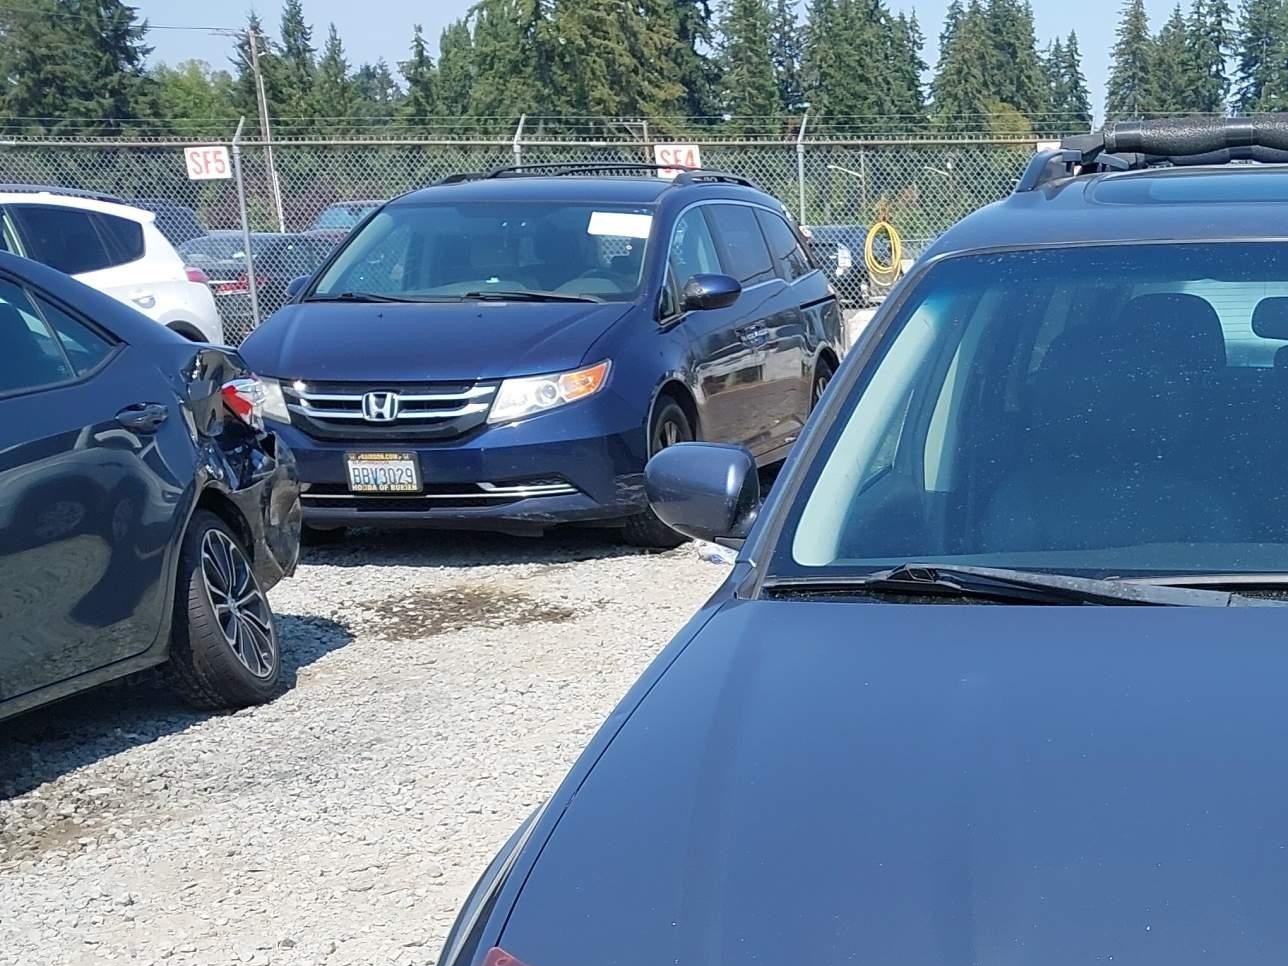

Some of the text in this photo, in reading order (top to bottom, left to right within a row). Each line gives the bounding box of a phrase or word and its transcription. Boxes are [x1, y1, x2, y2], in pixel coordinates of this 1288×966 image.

[190, 150, 226, 175] SF5
[660, 149, 697, 174] SF4
[351, 467, 414, 485] BBV3029
